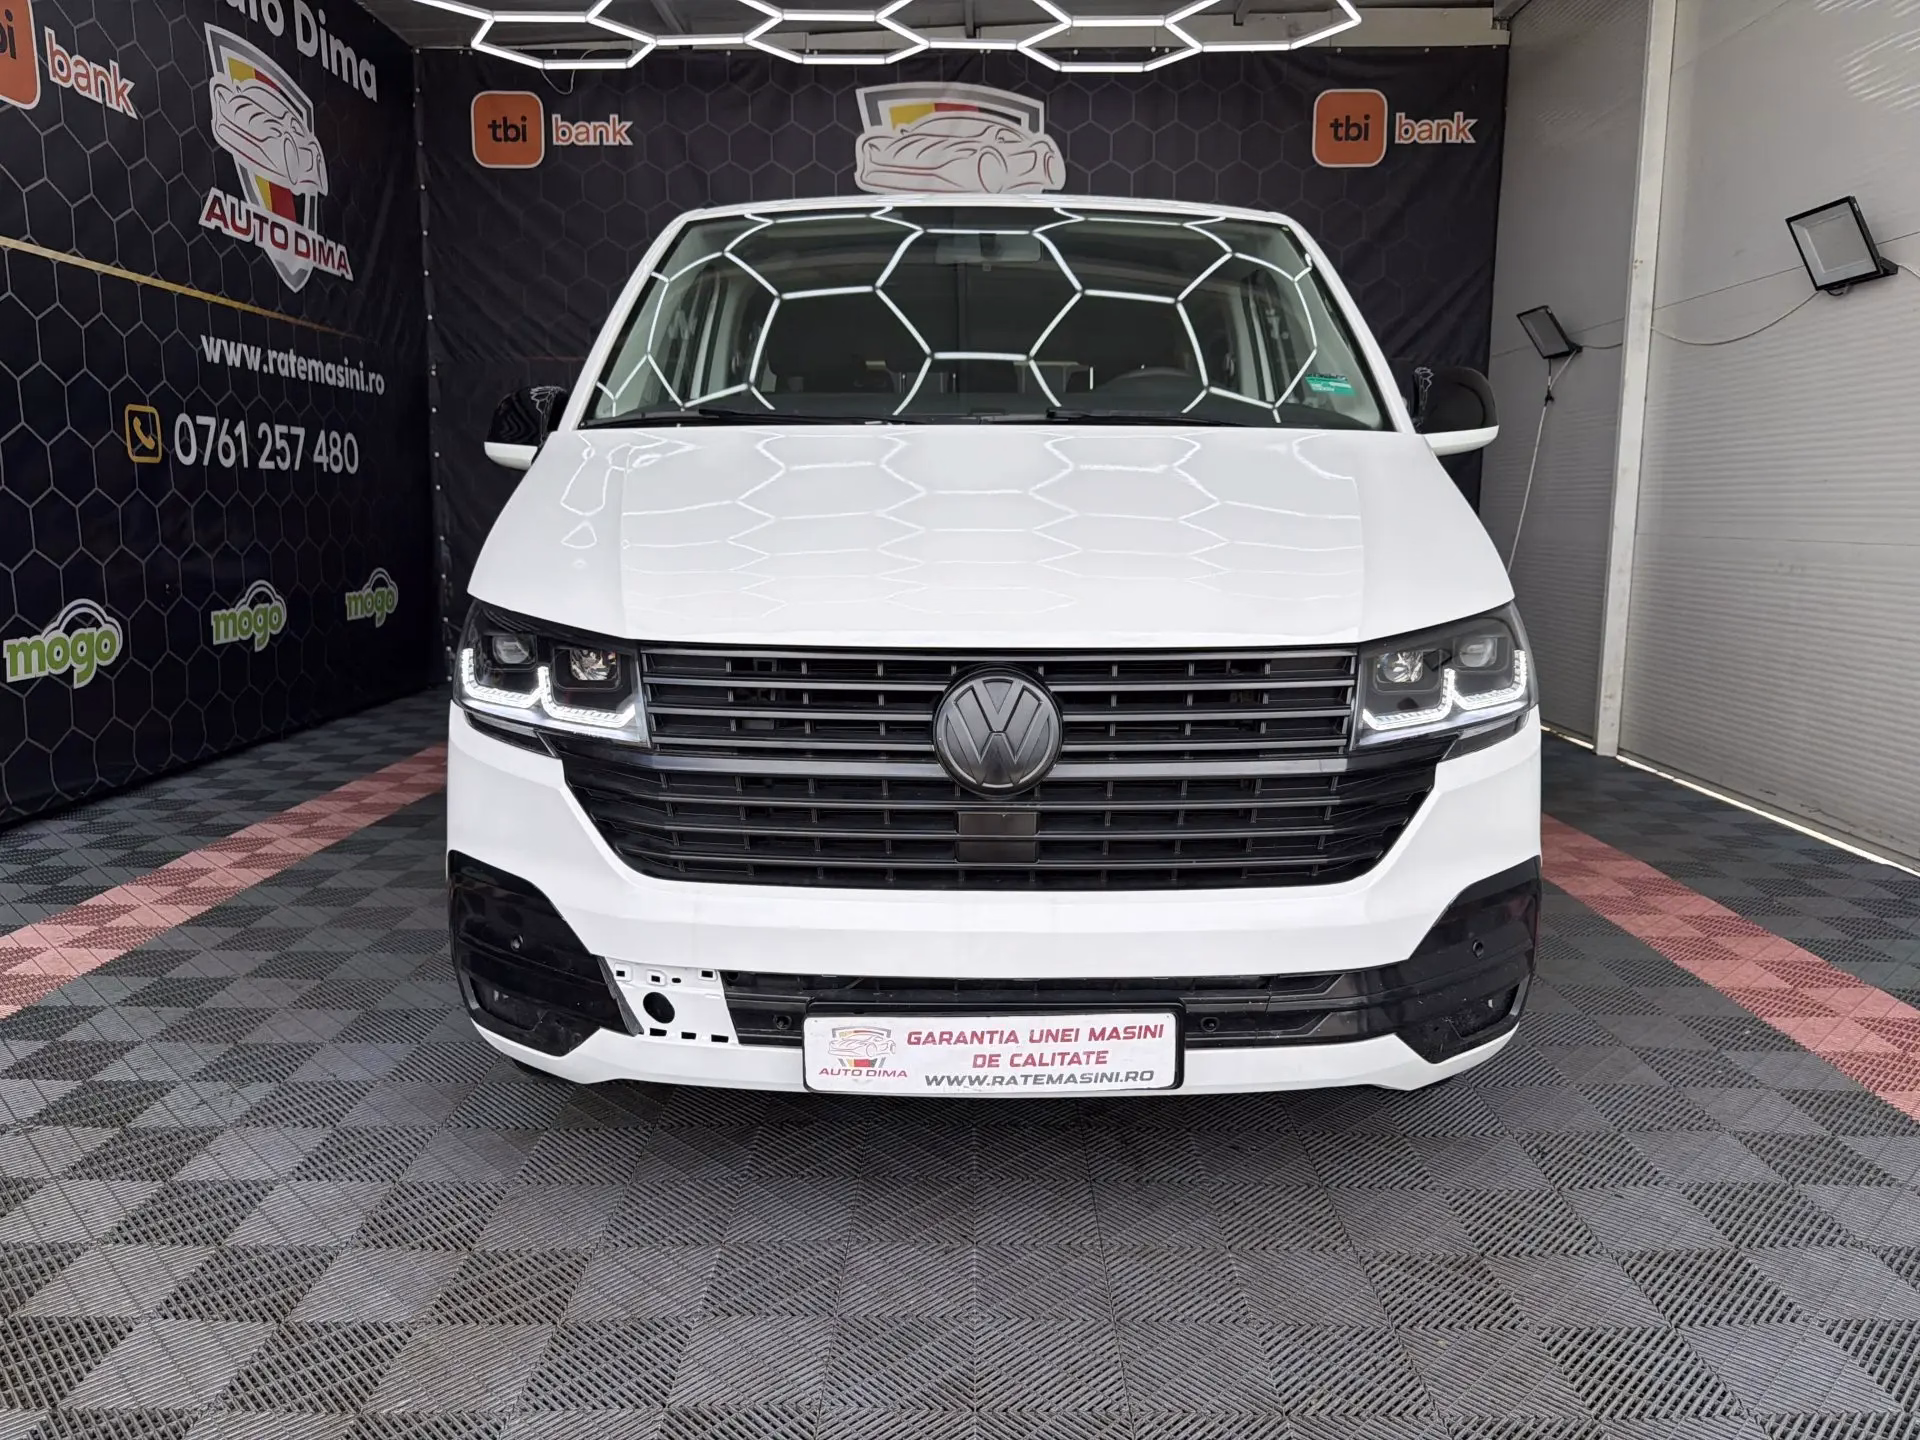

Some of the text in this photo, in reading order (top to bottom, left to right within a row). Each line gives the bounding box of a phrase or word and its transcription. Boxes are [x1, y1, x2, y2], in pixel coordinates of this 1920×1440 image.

[45, 28, 137, 118] bank
[294, 0, 378, 102] Dima
[488, 115, 633, 145] tbi bank
[1330, 113, 1477, 143] tbi bank
[203, 196, 351, 276] AUTO DIMA
[200, 334, 385, 396] www.ratemasini.ro
[174, 413, 360, 475] 0761 257 480
[211, 601, 285, 650] mogo
[345, 586, 396, 627] mogo
[5, 627, 118, 685] mogo
[907, 1024, 1164, 1045] GARANTIA UNEI MASINI
[818, 1067, 908, 1078] AUTO DIMA
[925, 1070, 1155, 1087] WWW.RATEMASINI.RO
[972, 1050, 1109, 1069] DE CALITATE
